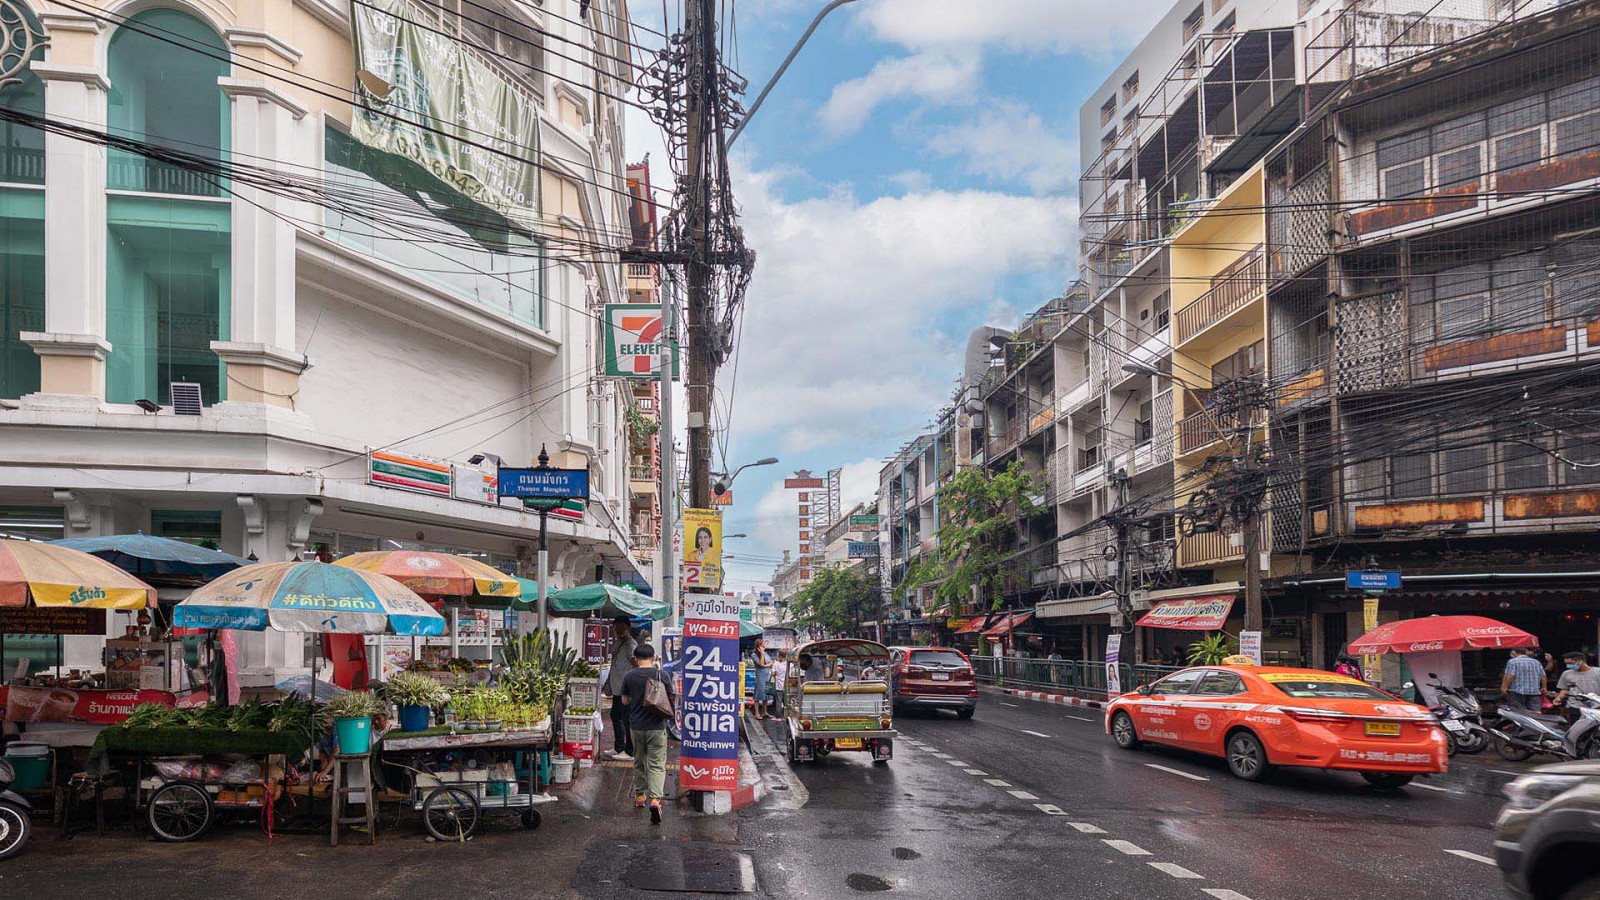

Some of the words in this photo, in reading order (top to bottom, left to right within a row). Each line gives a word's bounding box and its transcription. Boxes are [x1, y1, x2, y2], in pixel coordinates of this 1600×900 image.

[519, 472, 568, 484] ถนนมังกร
[687, 567, 700, 583] 2
[284, 593, 376, 610] #ดีทั่วดีถึง
[406, 601, 425, 612] 5G
[696, 600, 739, 615] ภูมิใจไทย
[1466, 626, 1510, 635] Coca-Cola
[1411, 641, 1444, 651] Coca-Cola
[685, 645, 722, 672] 24
[684, 700, 735, 712] เราพร้อม
[684, 713, 735, 739] ดูแล
[683, 740, 735, 751] คนกรุงเทพฯ
[712, 766, 735, 776] ภูมิใจ
